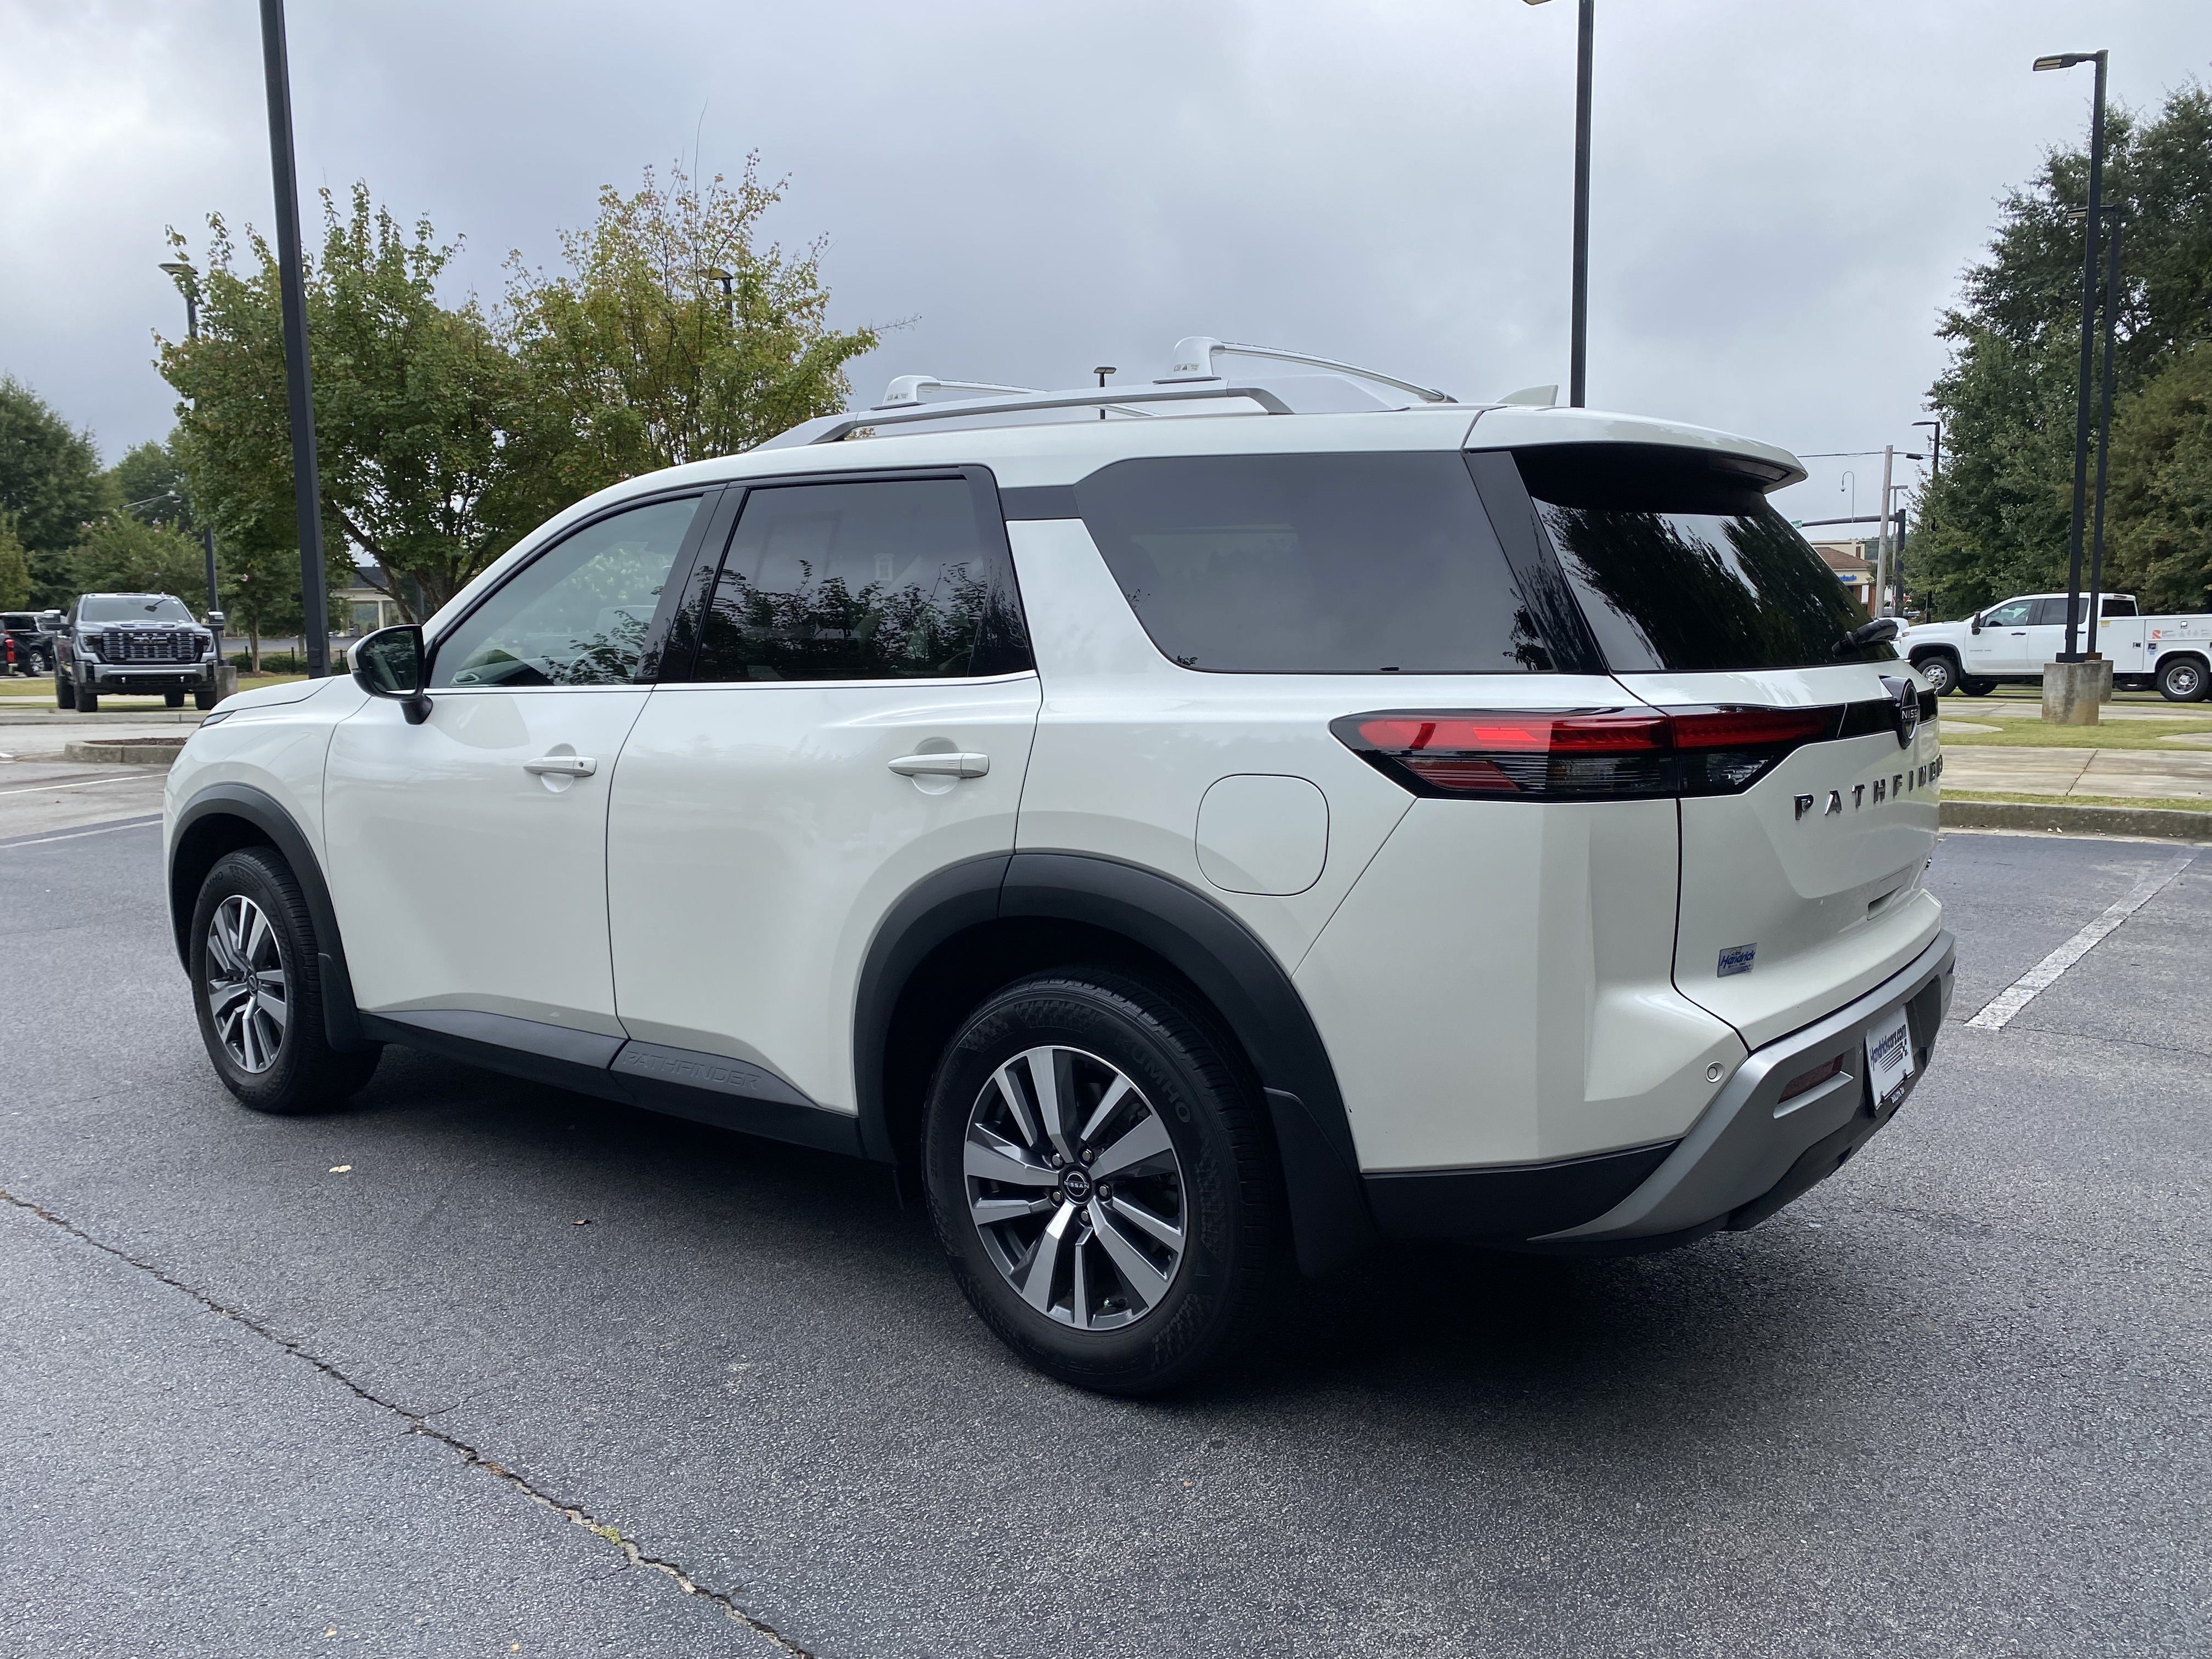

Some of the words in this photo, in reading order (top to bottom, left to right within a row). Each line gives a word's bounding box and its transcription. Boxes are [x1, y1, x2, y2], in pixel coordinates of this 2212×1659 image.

[622, 1050, 761, 1091] PATHFINDER
[1112, 1030, 1191, 1123] KUMHO
[1063, 1181, 1090, 1189] NISSAN
